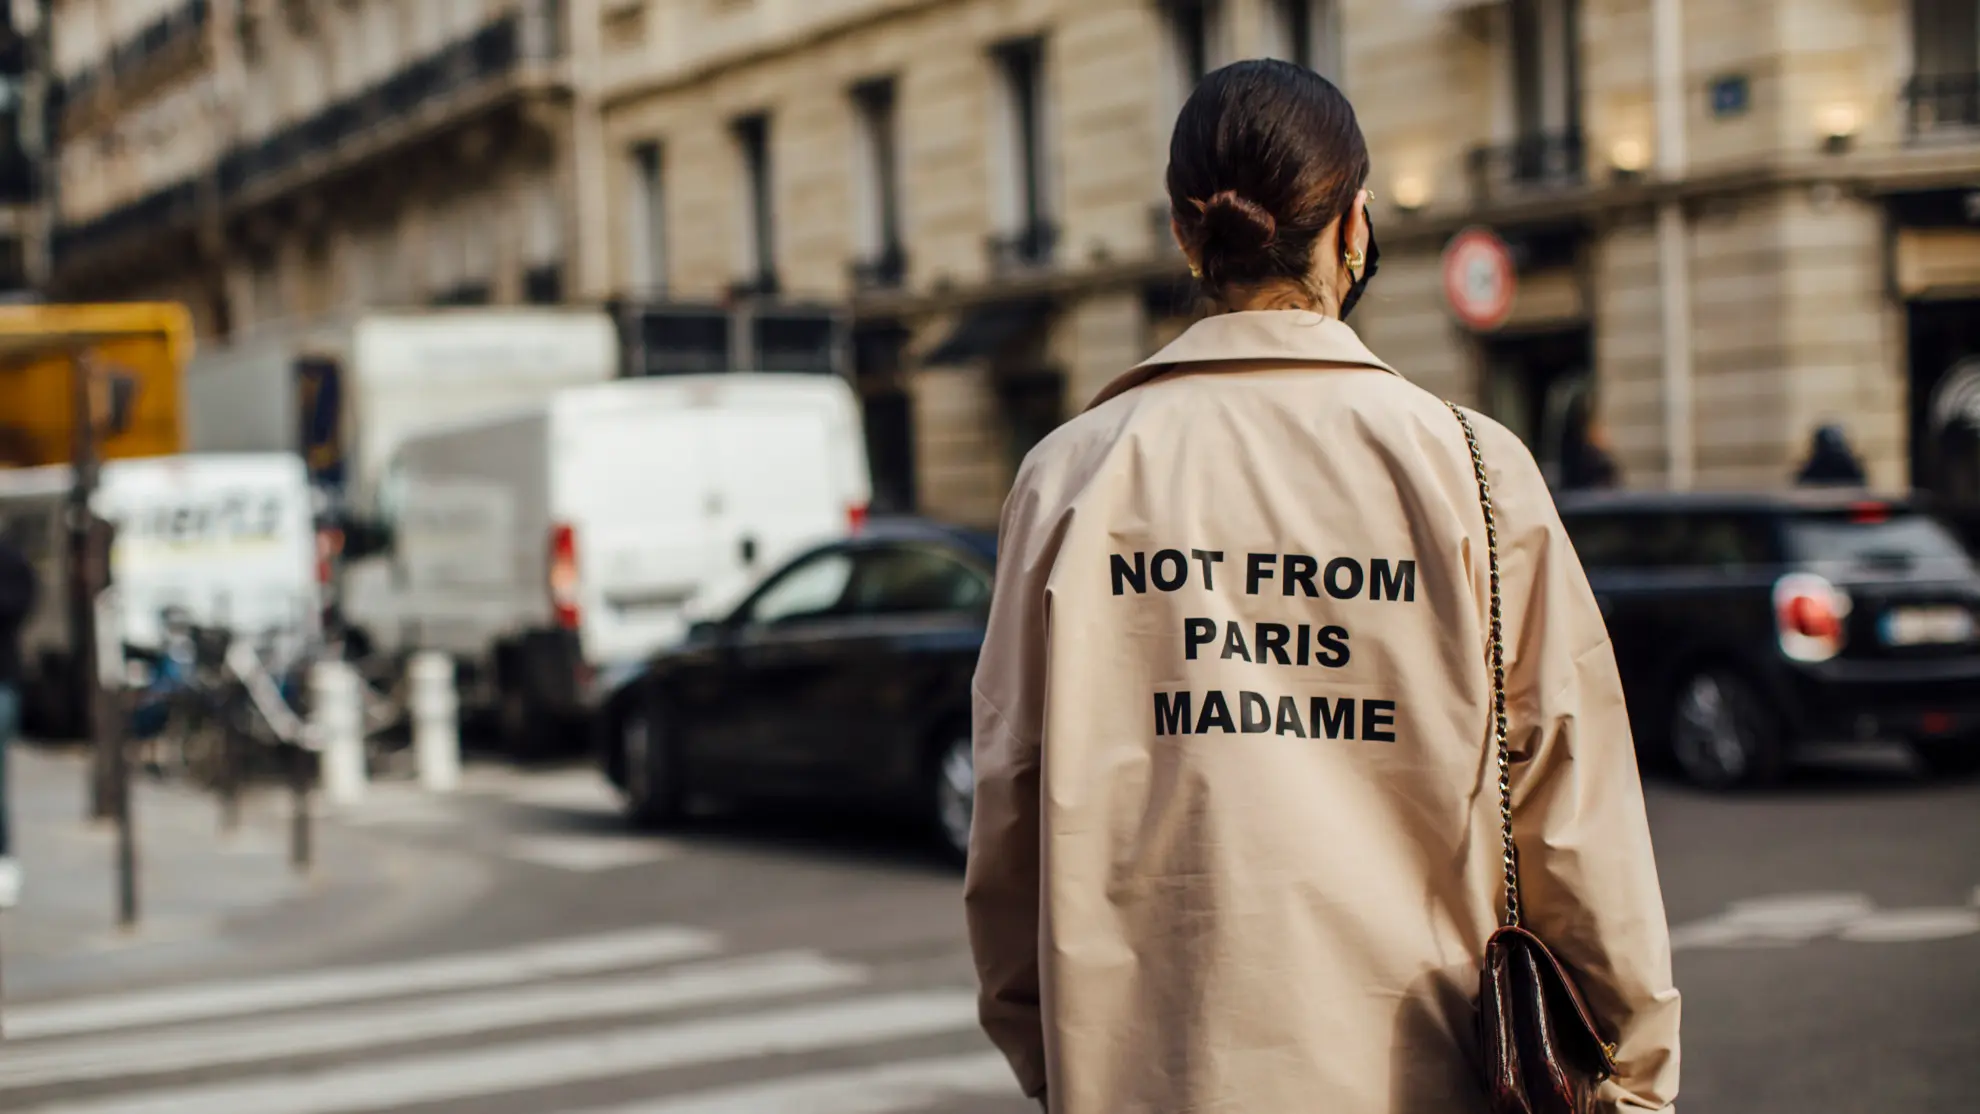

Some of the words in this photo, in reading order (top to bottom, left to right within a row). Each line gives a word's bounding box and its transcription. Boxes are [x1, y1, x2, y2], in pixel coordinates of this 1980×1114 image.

[1110, 549, 1224, 596] NOT
[1246, 553, 1416, 602] FROM
[1184, 617, 1351, 668] PARIS
[1153, 690, 1396, 743] MADAME
